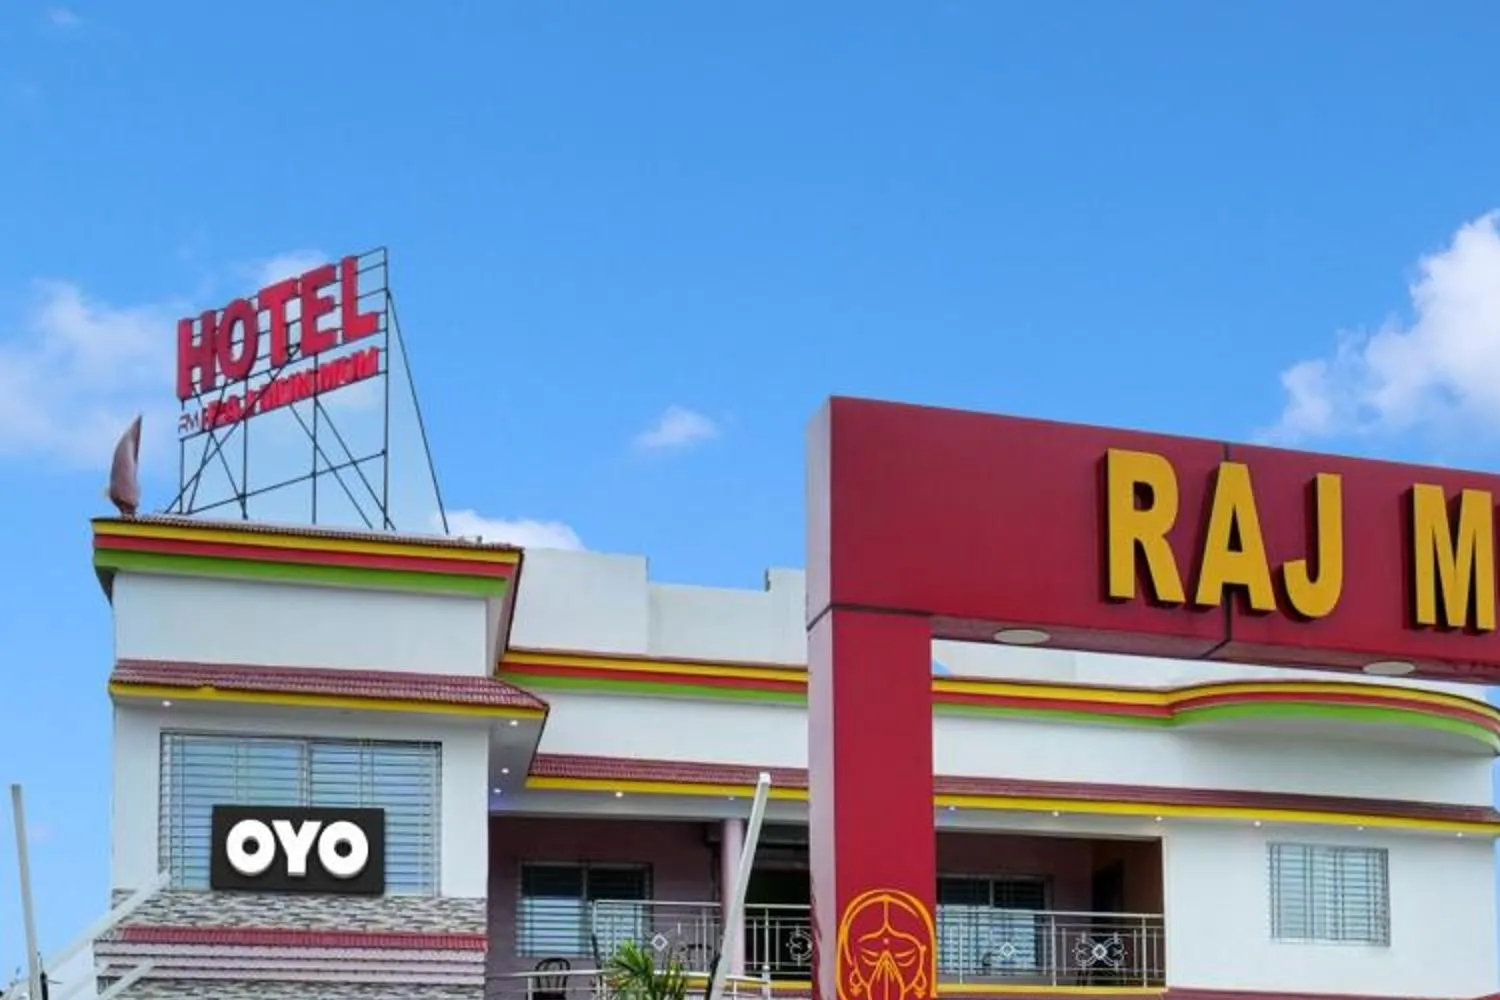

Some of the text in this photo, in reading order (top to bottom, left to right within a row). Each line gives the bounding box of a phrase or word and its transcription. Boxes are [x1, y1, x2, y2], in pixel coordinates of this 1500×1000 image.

[177, 256, 379, 400] HOTEL
[1105, 447, 1343, 618] RAJ
[226, 819, 369, 878] OYO
